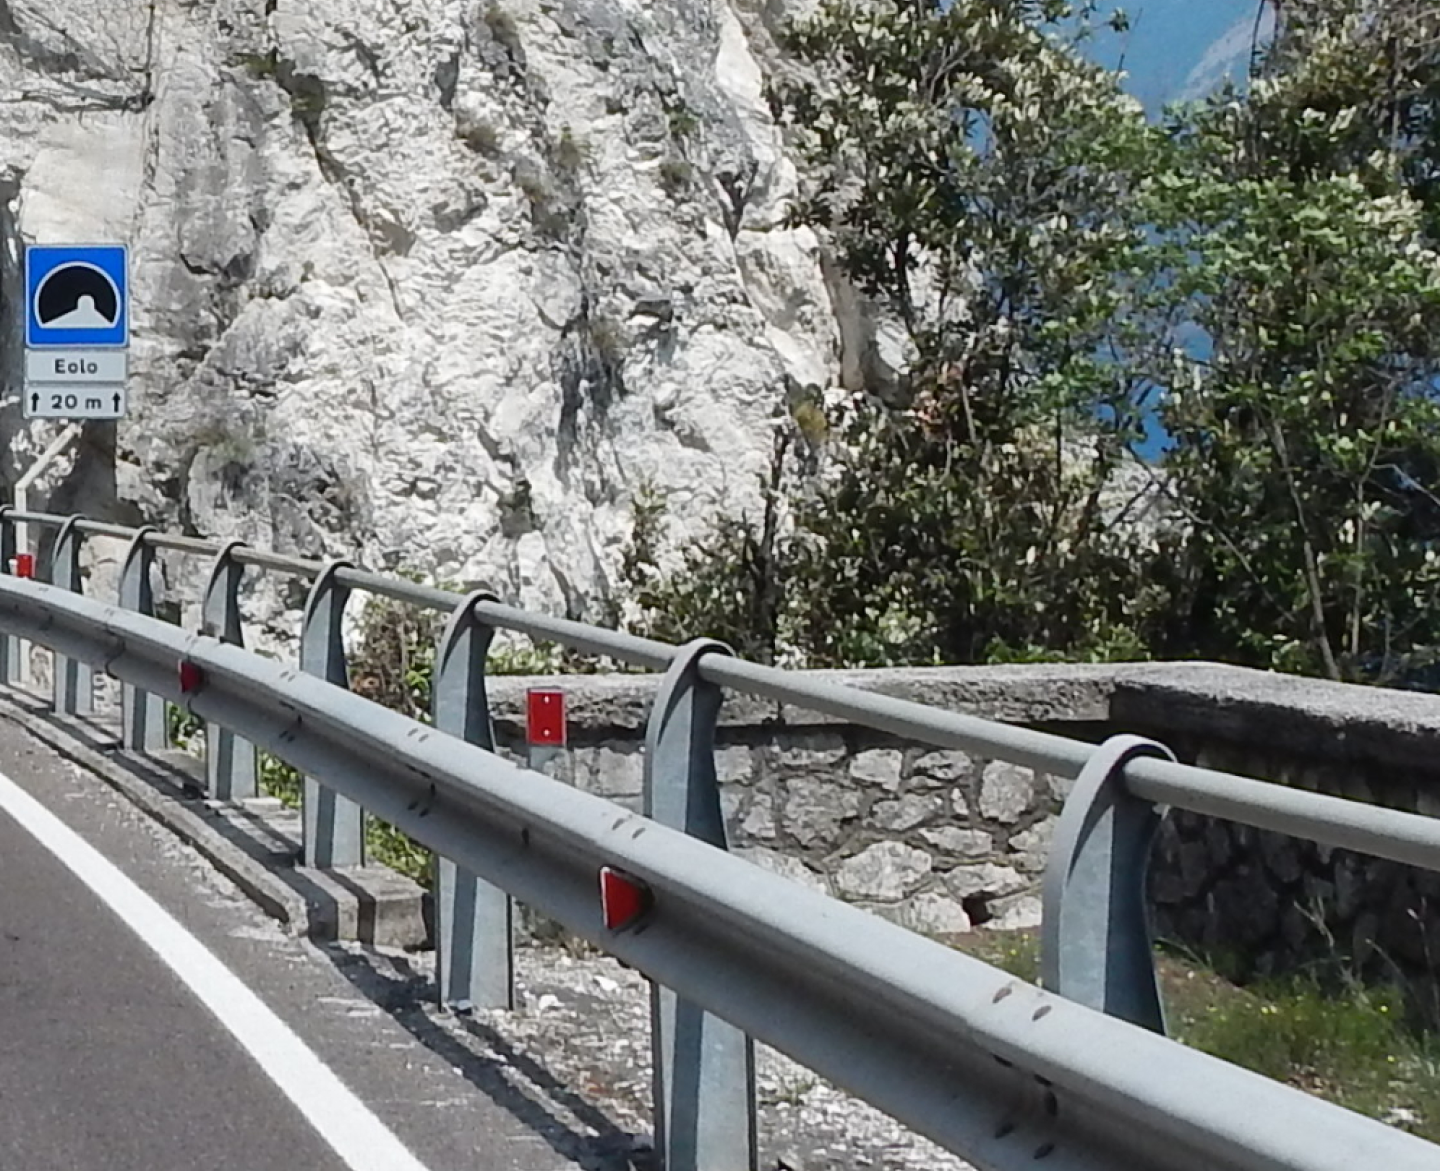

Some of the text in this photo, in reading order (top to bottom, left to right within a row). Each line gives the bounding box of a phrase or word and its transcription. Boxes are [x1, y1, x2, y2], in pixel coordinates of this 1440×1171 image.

[54, 358, 98, 374] Eolo
[51, 395, 102, 409] 20 m
